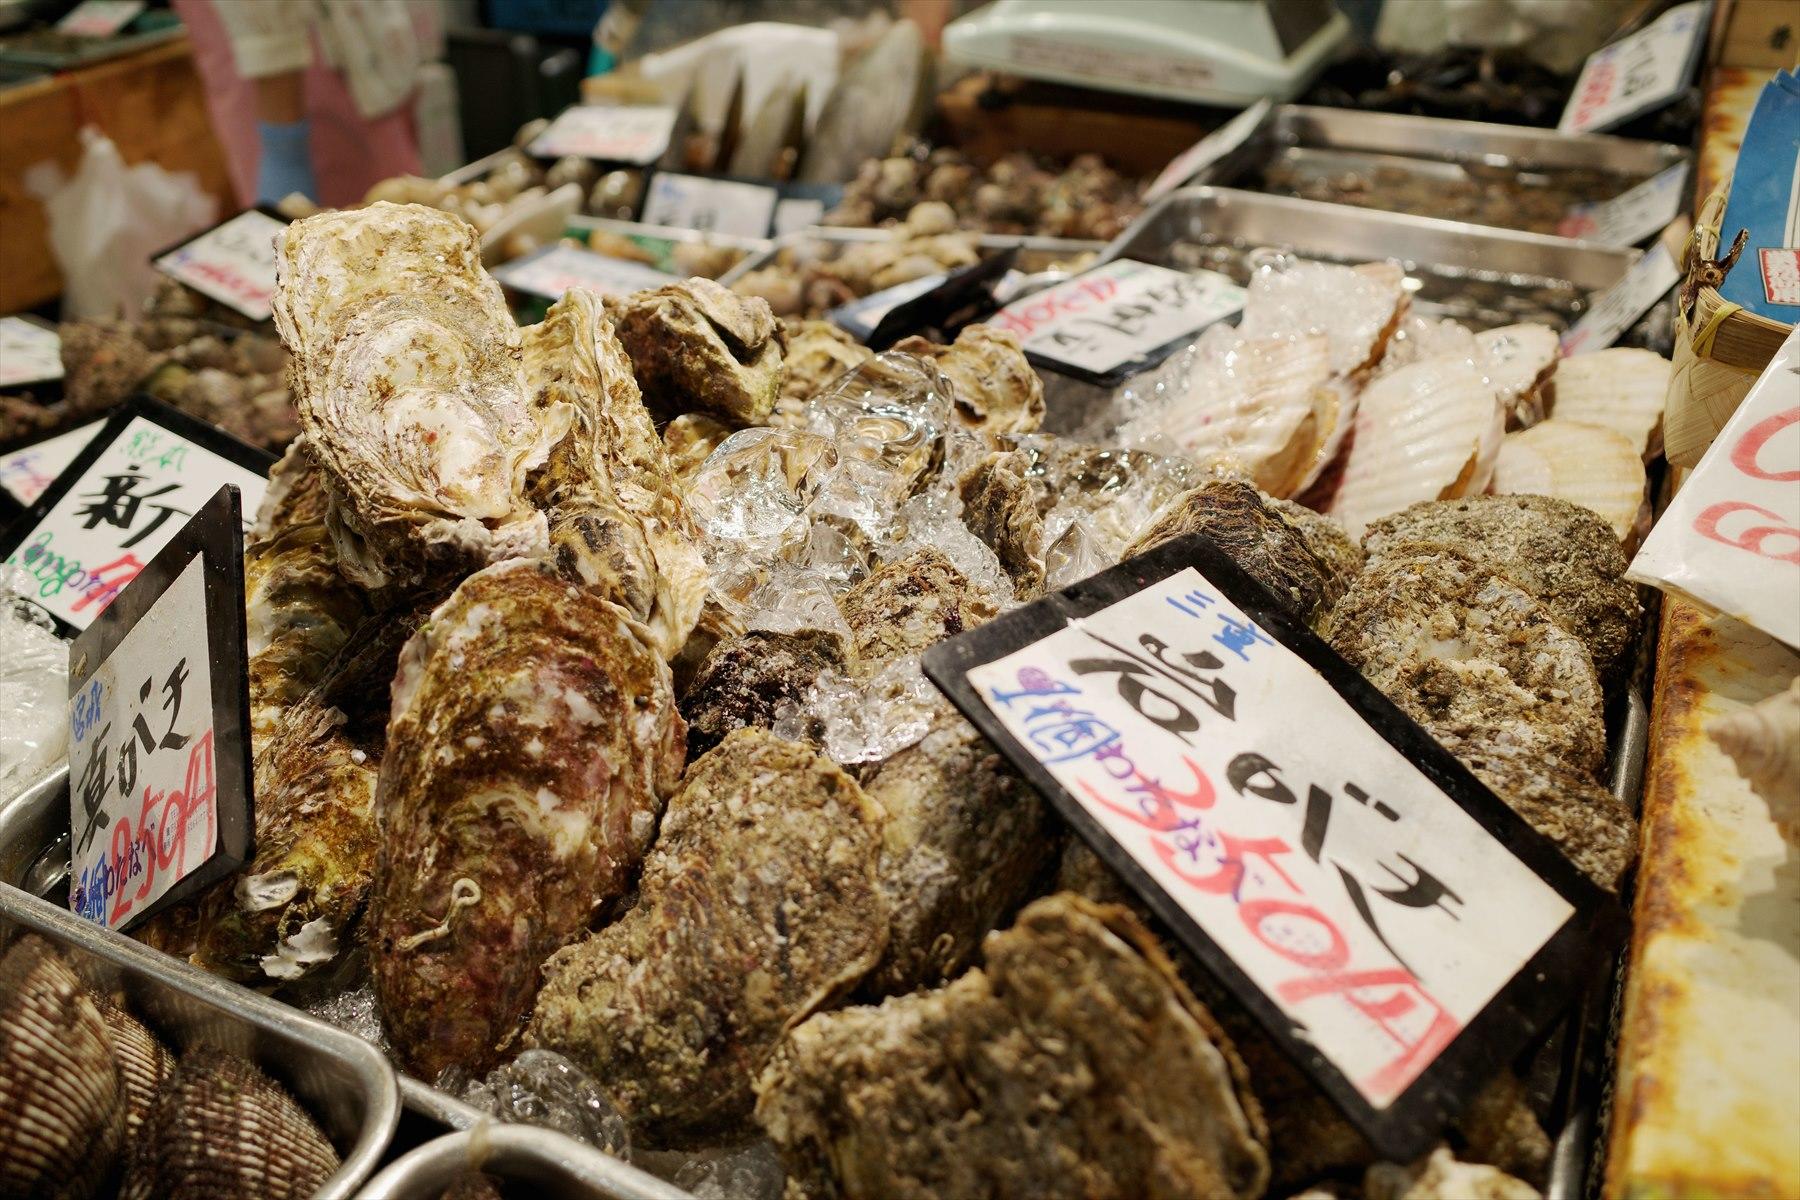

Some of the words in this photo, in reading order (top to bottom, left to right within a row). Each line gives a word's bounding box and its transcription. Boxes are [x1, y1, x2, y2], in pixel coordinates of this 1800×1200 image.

[1165, 589, 1275, 662] 三重
[76, 656, 190, 855] 真がき
[109, 727, 216, 927] 250円
[1068, 628, 1464, 984] 岩がき
[1073, 754, 1463, 1095] 350円
